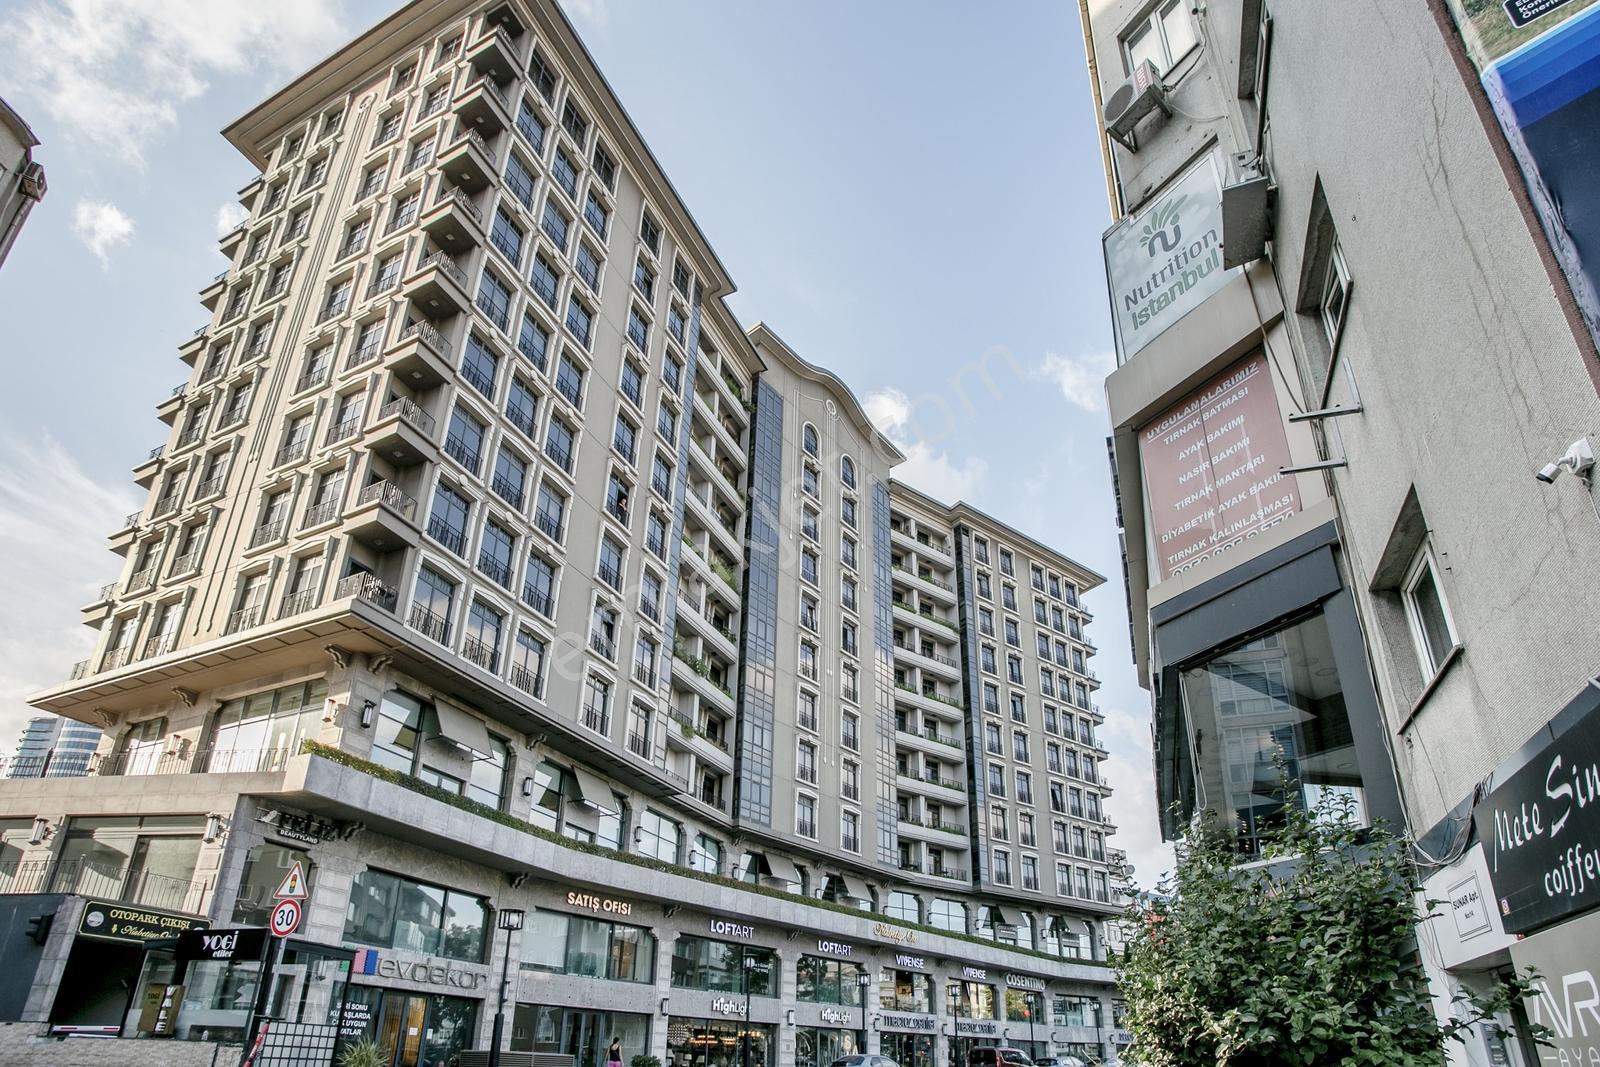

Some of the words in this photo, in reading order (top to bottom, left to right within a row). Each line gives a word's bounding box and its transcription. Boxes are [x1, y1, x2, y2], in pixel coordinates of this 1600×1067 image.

[1124, 228, 1218, 313] Nutrition
[1131, 247, 1220, 331] Istanbul
[1146, 361, 1259, 440] UYGULAMALARIMIZ
[1164, 417, 1201, 445] TIRNAK
[1202, 386, 1249, 421] BATMASI
[1178, 439, 1205, 461] AYAK
[1206, 414, 1245, 443] BAKIMI
[1178, 460, 1211, 484] NASIR
[1211, 436, 1251, 465] BAKIMI
[1174, 483, 1214, 512] TIRNAK
[1215, 454, 1266, 489] MANTARI
[1218, 490, 1248, 513] AYAK
[1248, 471, 1289, 496] BAKI
[1167, 538, 1207, 565] TIRNAK
[1208, 493, 1295, 545] KALINLAŞMASI
[280, 829, 318, 845] BEAUTYLAND
[1494, 802, 1544, 873] Mete
[567, 892, 600, 913] SATIŞ
[110, 909, 160, 925] OTOPARK
[160, 917, 191, 931] ÇIKIŞI
[276, 909, 295, 927] 30
[710, 919, 755, 939] LOFTART
[212, 949, 234, 958] etiler
[818, 940, 852, 957] LOFTART
[895, 954, 925, 969] VIVENSE
[377, 957, 487, 990] evdekor
[1006, 973, 1046, 991] COSENTINO
[155, 986, 177, 1032] VALE
[329, 1010, 371, 1020] KUAŞLARDA
[351, 1003, 368, 1011] SONU
[712, 997, 752, 1016] HighLig
[821, 1008, 852, 1024] HighLight
[340, 1028, 362, 1036] ATLAR
[346, 1020, 367, 1028] UYGUN
